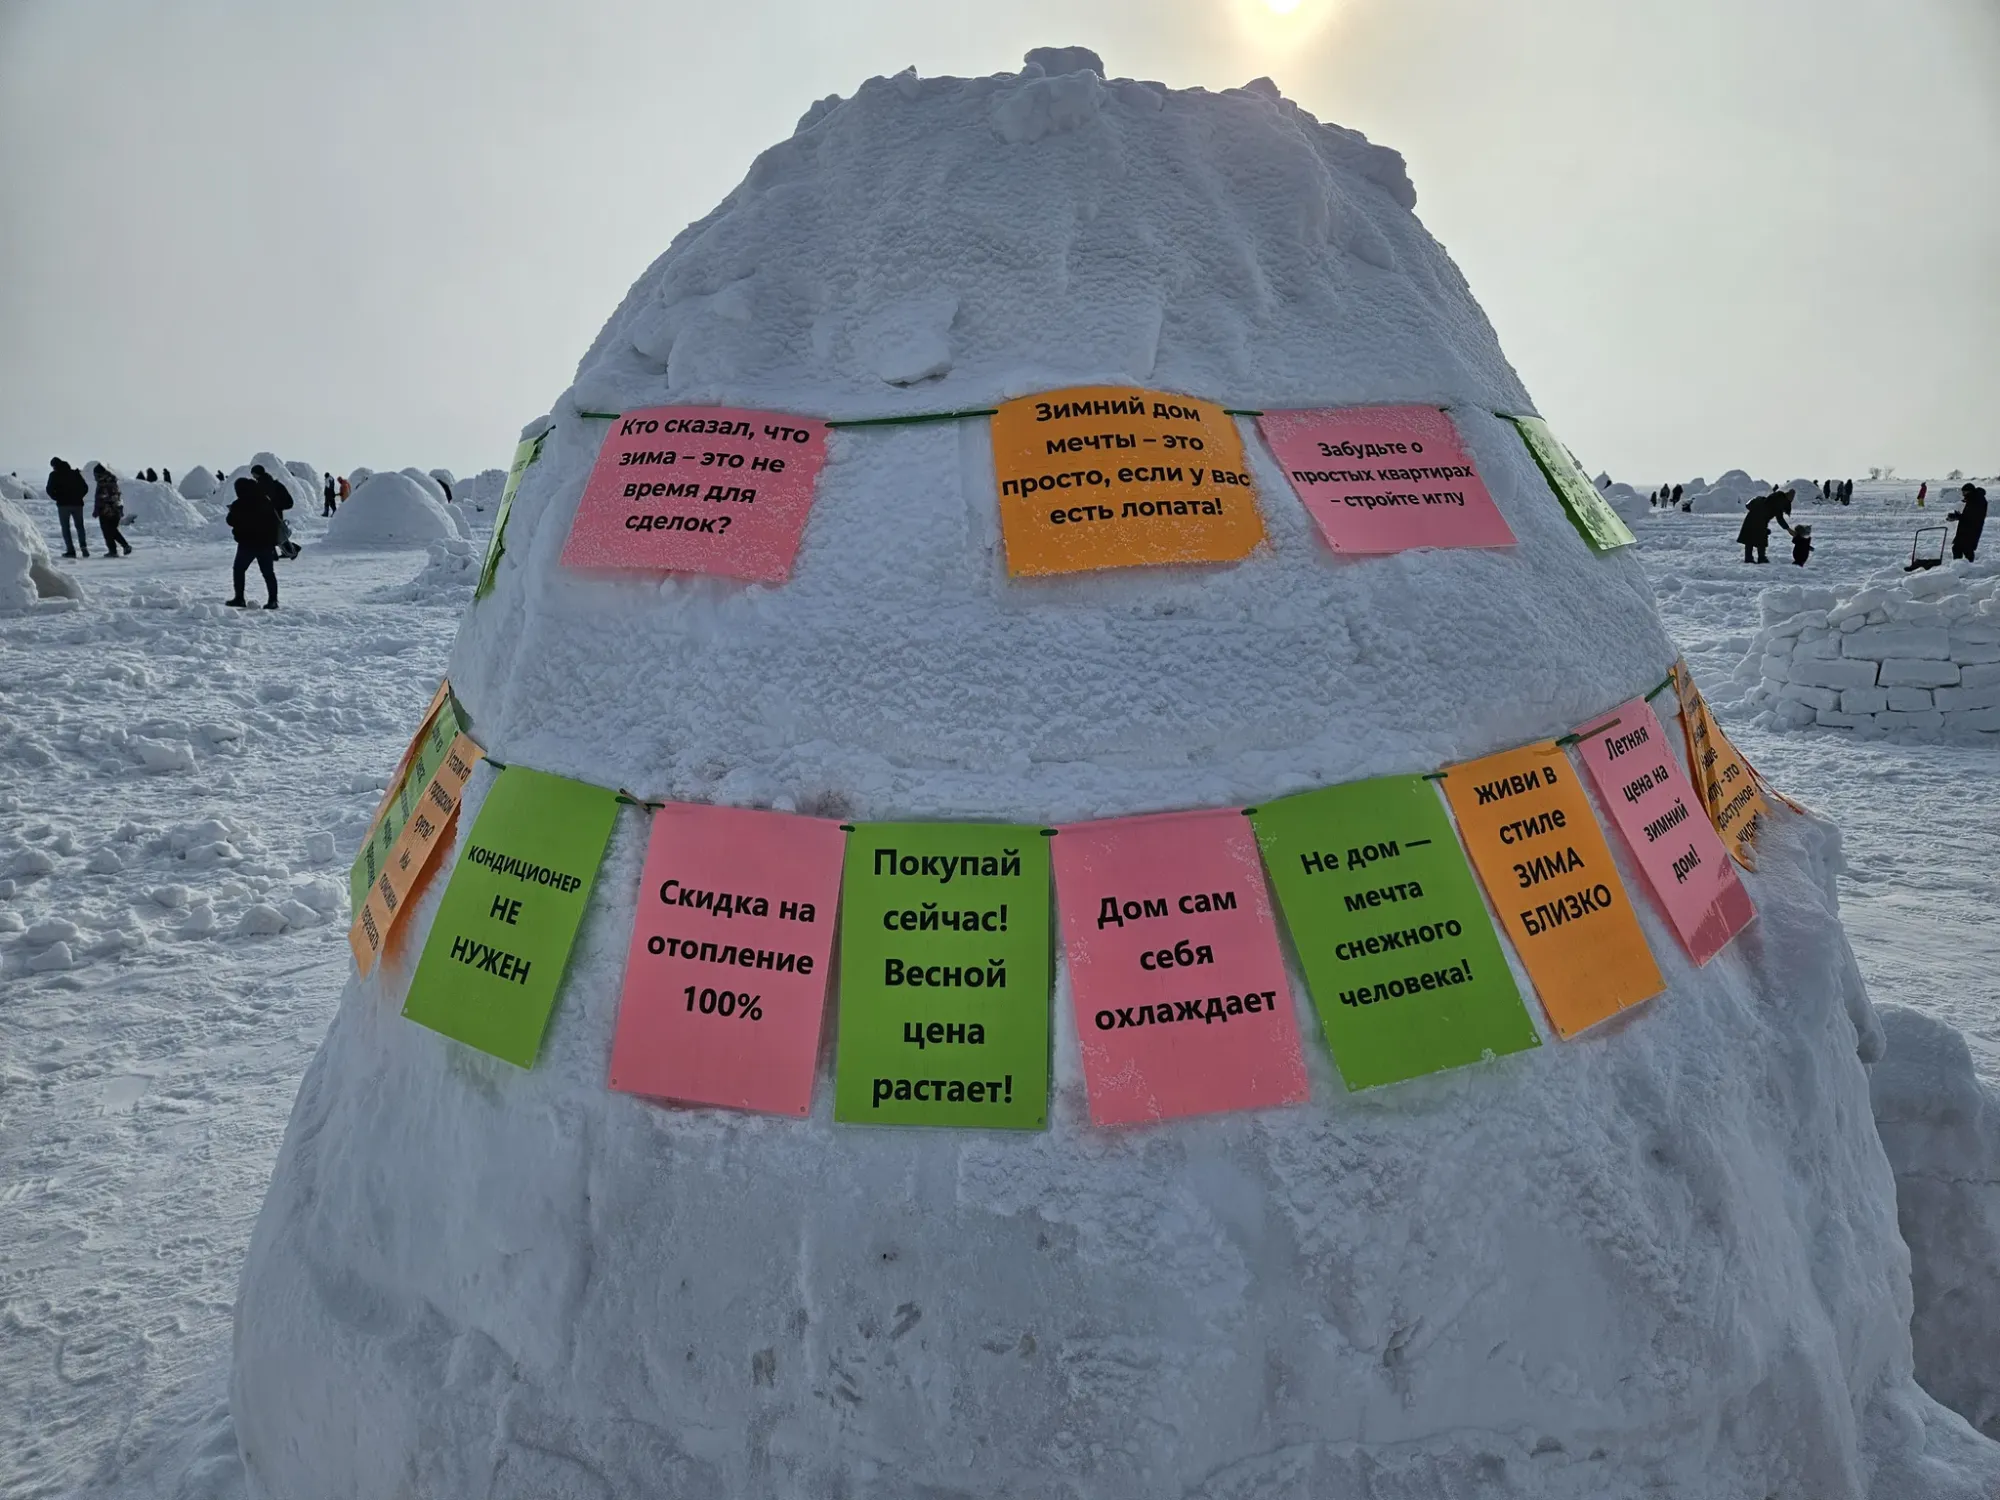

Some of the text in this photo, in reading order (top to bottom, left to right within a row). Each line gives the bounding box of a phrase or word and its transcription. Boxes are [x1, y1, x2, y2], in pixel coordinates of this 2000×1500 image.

[1036, 396, 1200, 421] Зимний дом
[620, 417, 809, 443] Кто сказал, что
[1047, 434, 1136, 454] мечты
[1163, 435, 1203, 450] это
[619, 451, 676, 465] зима
[700, 452, 744, 468] это
[751, 457, 785, 472] не
[1318, 441, 1423, 459] Забудьте о
[1003, 467, 1250, 498] просто, если у вас
[1292, 466, 1474, 485] простых квартирах
[623, 483, 756, 503] время для
[1344, 492, 1419, 510] стройте
[1422, 492, 1464, 506] иглу
[626, 516, 731, 534] сделок?
[1050, 498, 1223, 524] есть лопата!
[1605, 727, 1649, 760] Летняя
[1622, 765, 1669, 804] цена на
[1723, 763, 1740, 783] это
[1644, 798, 1689, 842] зимний
[1717, 784, 1755, 832] доступное
[1499, 808, 1567, 844] стиле
[468, 846, 581, 893] КОНДИЦИОНЕР
[875, 849, 1020, 883] Покупай
[1300, 852, 1339, 874] Не
[1348, 841, 1400, 870] дом
[1513, 847, 1584, 888] ЗИМА
[1673, 844, 1701, 884] дом!
[490, 895, 522, 925] НЕ
[660, 880, 815, 922] Скидка на
[1098, 892, 1237, 929] Дом сам
[1344, 882, 1423, 912] мечта
[1520, 884, 1612, 936] БЛИЗКО
[884, 903, 1007, 931] сейчас!
[648, 936, 813, 974] отопление
[1140, 940, 1213, 970] себя
[1336, 920, 1461, 960] снежного
[451, 936, 531, 984] НУЖЕН
[886, 959, 1005, 987] Весной
[1339, 959, 1473, 1007] человека!
[685, 986, 762, 1020] 100%
[1096, 991, 1276, 1030] охлаждает
[904, 1023, 984, 1049] цена
[873, 1075, 1012, 1108] растает!
